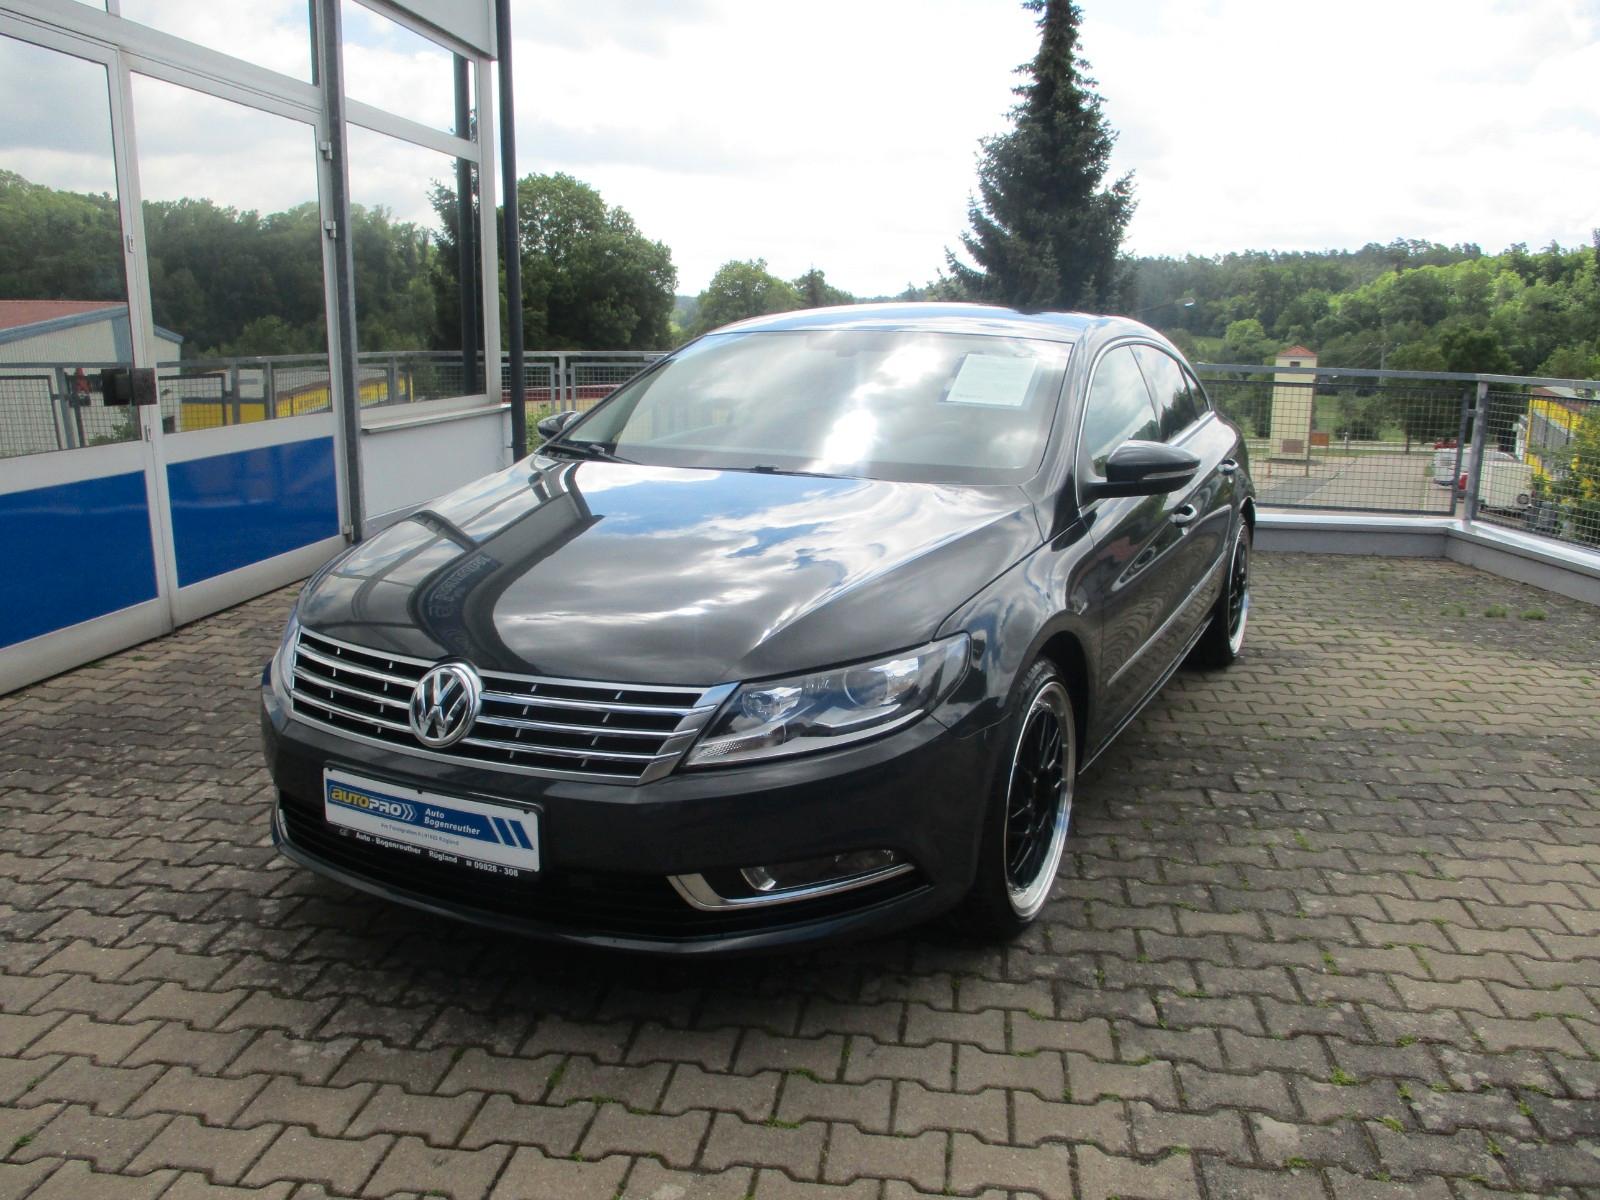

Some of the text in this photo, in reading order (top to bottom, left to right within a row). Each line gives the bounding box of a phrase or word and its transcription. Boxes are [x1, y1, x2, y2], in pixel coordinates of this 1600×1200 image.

[425, 807, 445, 819] Auto
[424, 816, 481, 835] Bogenreuther
[355, 831, 371, 842] Auto
